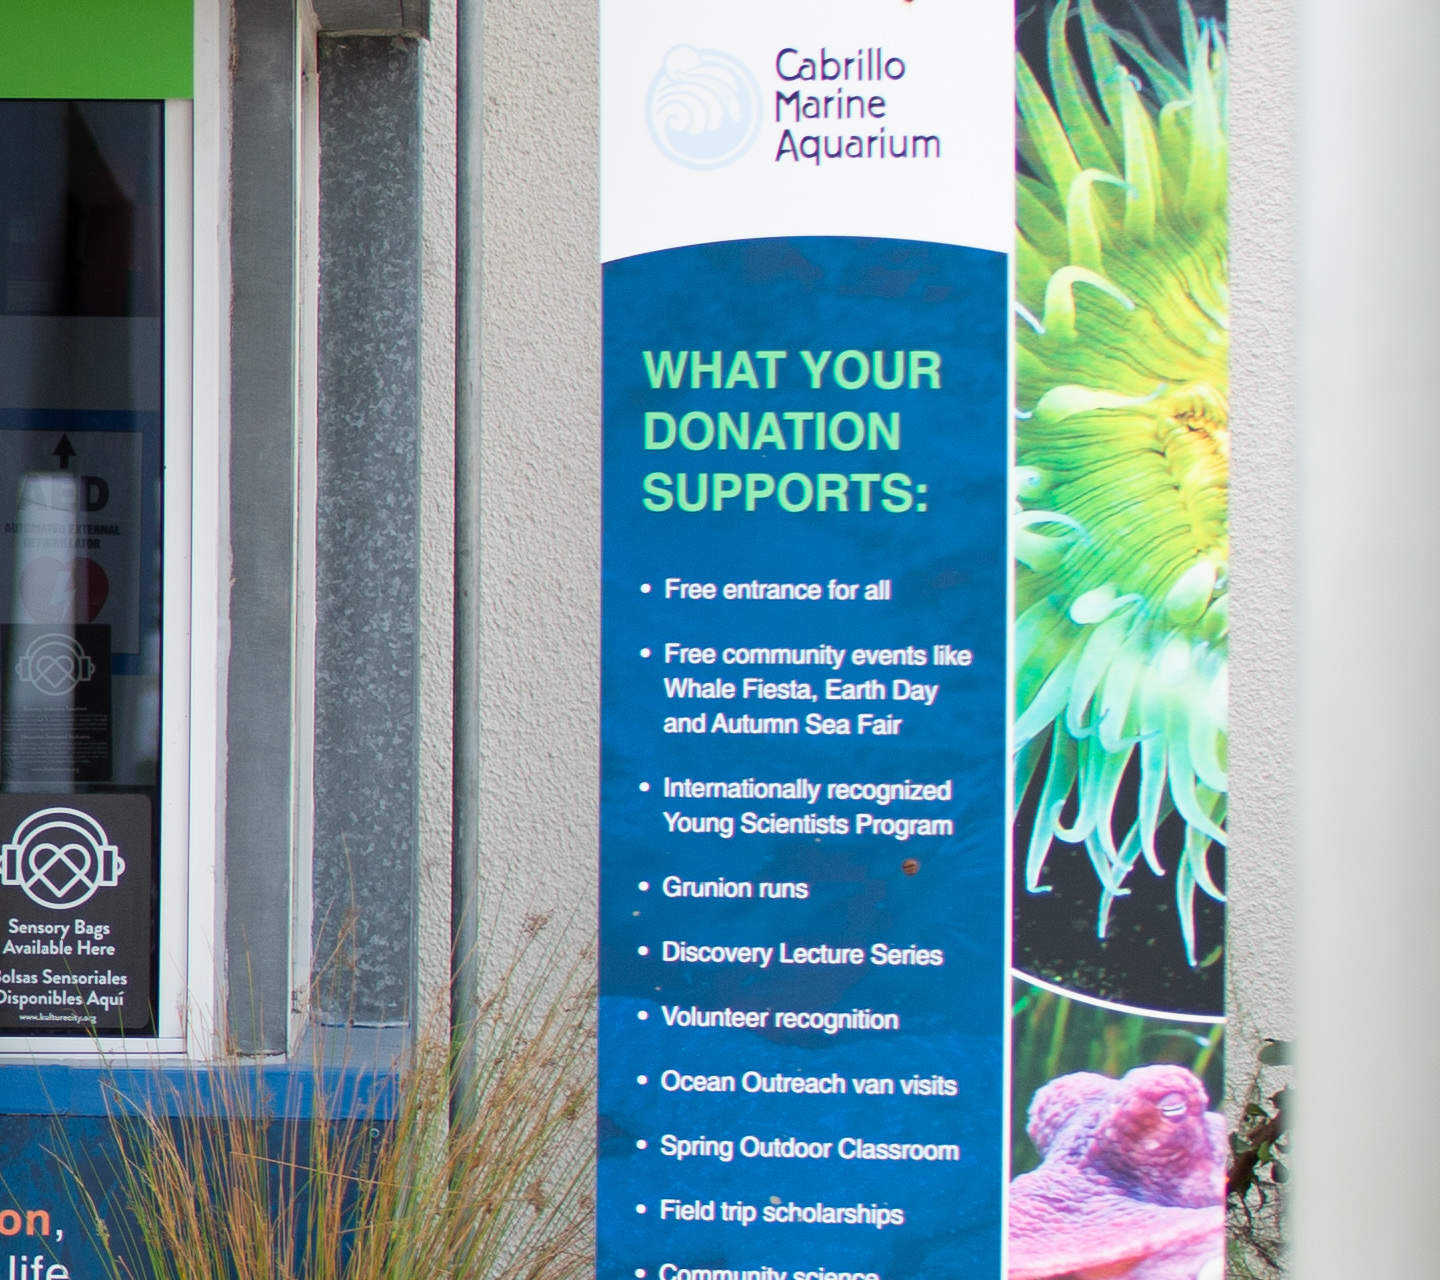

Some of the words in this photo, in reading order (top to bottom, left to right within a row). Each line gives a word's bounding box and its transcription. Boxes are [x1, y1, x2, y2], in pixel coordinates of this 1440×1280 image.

[776, 48, 905, 81] Cabrillo
[776, 88, 885, 122] Marine
[776, 128, 939, 165] Aquarium
[642, 351, 786, 388] WHAT
[800, 350, 940, 390] YOUR
[644, 411, 899, 451] DONATION
[643, 472, 926, 513] SUPPORTS:
[665, 578, 716, 599] Free
[723, 580, 821, 600] entrance
[827, 579, 859, 600] for
[864, 580, 890, 600] all
[665, 643, 716, 664] Free
[722, 644, 845, 670] community
[851, 646, 927, 665] events
[933, 645, 972, 666] like
[664, 678, 735, 698] Whale
[743, 678, 817, 702] Fiesta,
[825, 679, 885, 699] Earth
[893, 680, 938, 705] Day
[663, 713, 705, 733] and
[711, 713, 798, 733] Autumn
[805, 713, 850, 734] Sea
[858, 714, 902, 735] Fair
[664, 777, 821, 804] Internationally
[828, 780, 951, 805] recognized
[663, 812, 733, 838] Young
[740, 812, 849, 834] Scientists
[856, 814, 952, 840] Program
[663, 876, 751, 897] Grunion
[760, 883, 808, 898] runs
[9, 919, 70, 943] Sensory
[75, 919, 110, 940] Bags
[3, 936, 72, 955] Available
[78, 940, 115, 955] Here
[663, 941, 773, 968] Discovery
[780, 943, 864, 964] Lecture
[870, 943, 943, 965] Series
[42, 969, 127, 985] Sensoriales
[86, 990, 124, 1011] Aquí
[661, 1006, 769, 1027] Volunteer
[775, 1009, 898, 1034] recognition
[661, 1070, 735, 1091] Ocean
[742, 1071, 845, 1093] Outreach
[852, 1079, 893, 1094] van
[899, 1075, 957, 1096] visits
[661, 1135, 733, 1161] Spring
[740, 1136, 832, 1158] Outdoor
[838, 1138, 959, 1160] Classroom
[661, 1199, 714, 1220] Field
[720, 1201, 756, 1226] trip
[763, 1202, 904, 1229] scholarships
